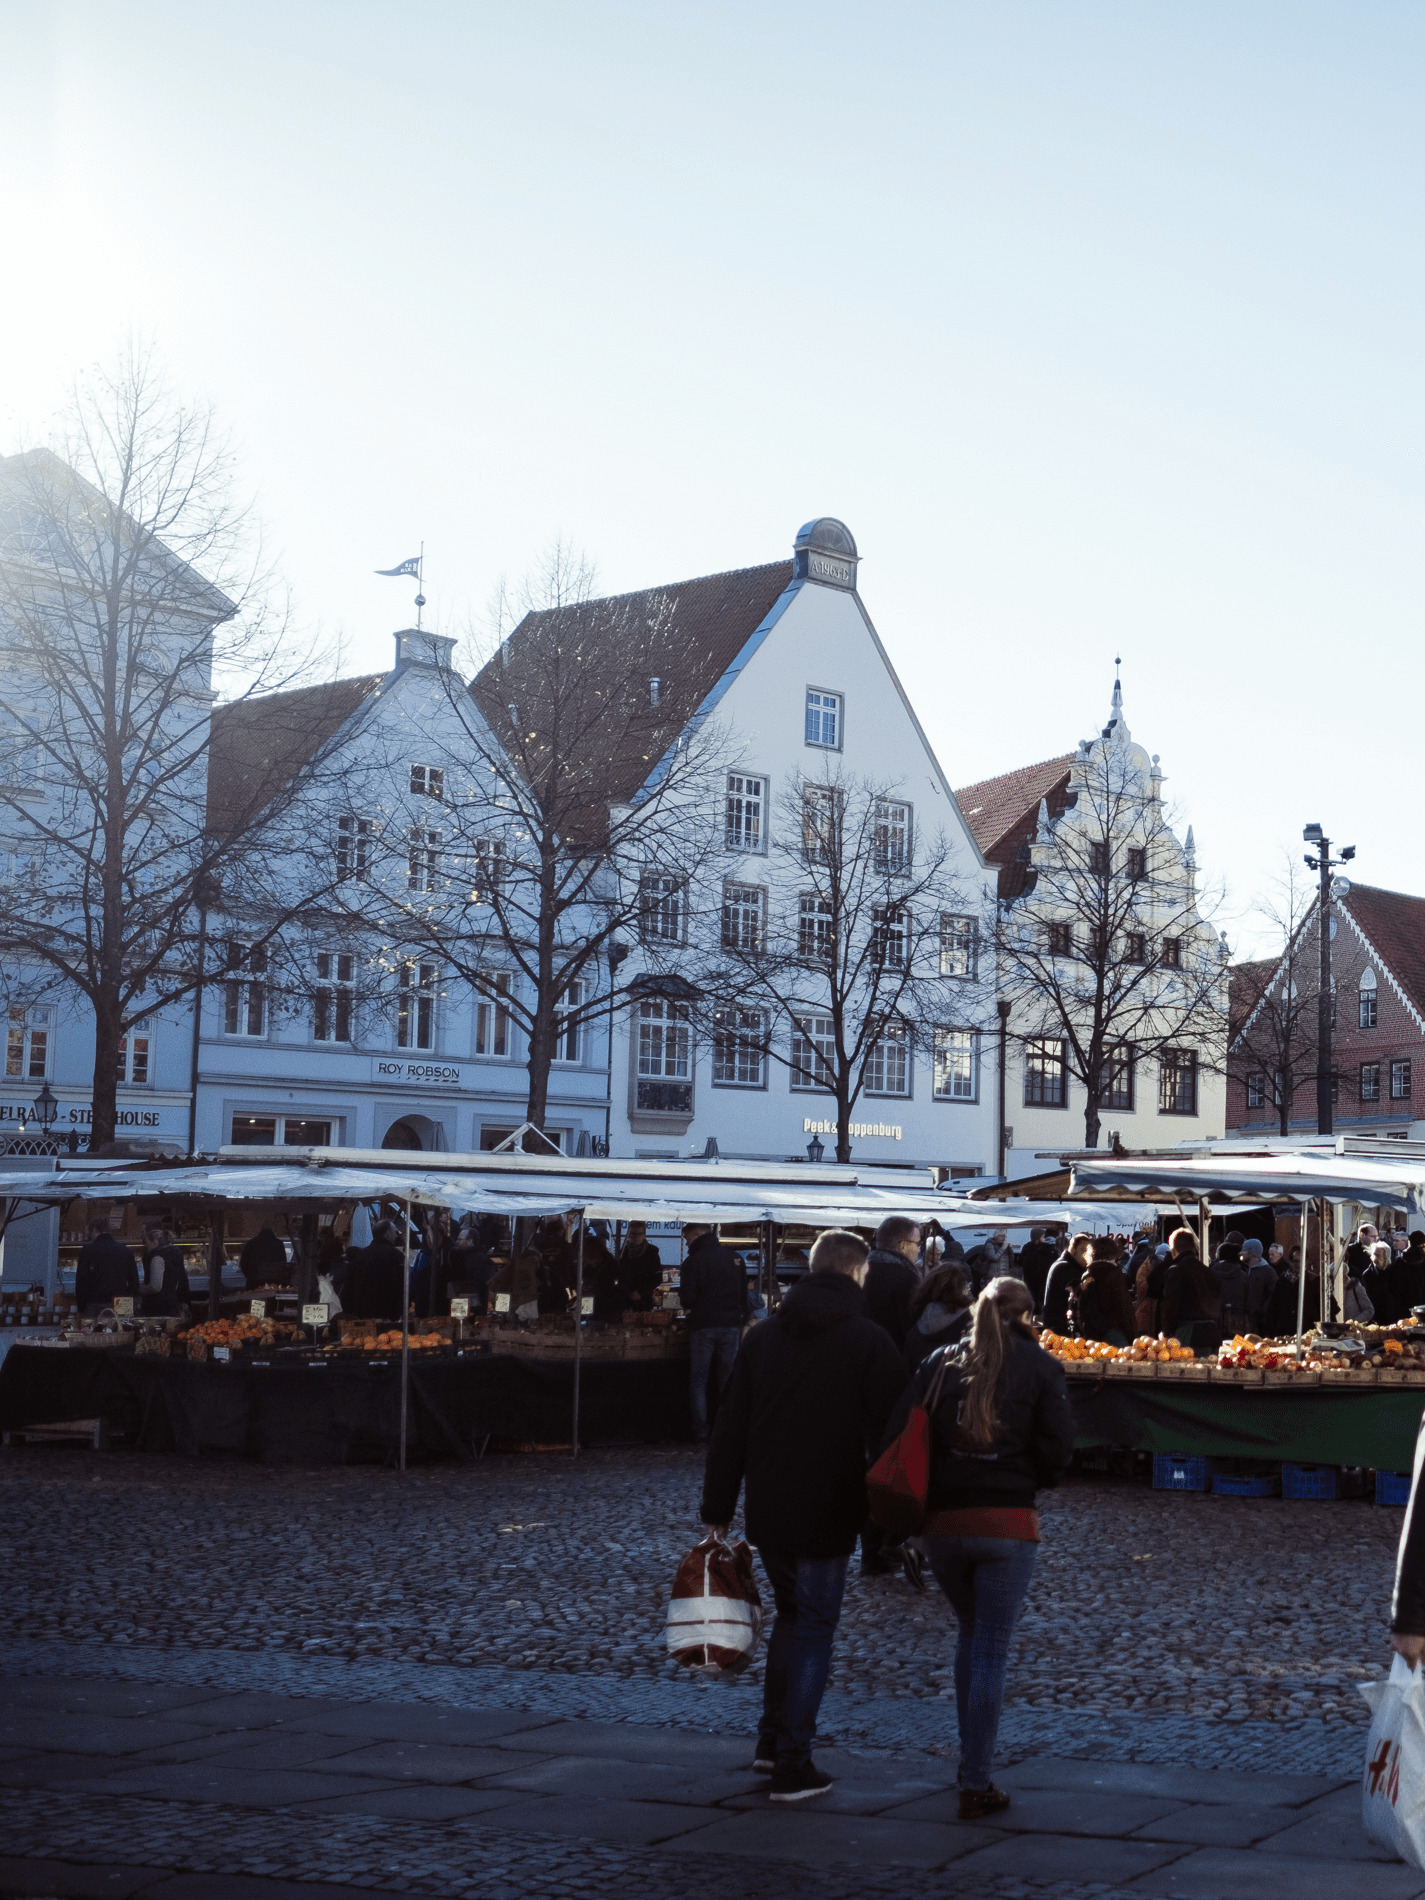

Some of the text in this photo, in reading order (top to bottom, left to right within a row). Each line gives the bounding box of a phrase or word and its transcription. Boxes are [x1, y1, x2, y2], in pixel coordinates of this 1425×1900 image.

[378, 1063, 460, 1078] ROY ROBSON
[0, 1106, 58, 1123] ELRA
[69, 1109, 160, 1126] STEHOUSE
[803, 1118, 902, 1140] Peek&oppenburg
